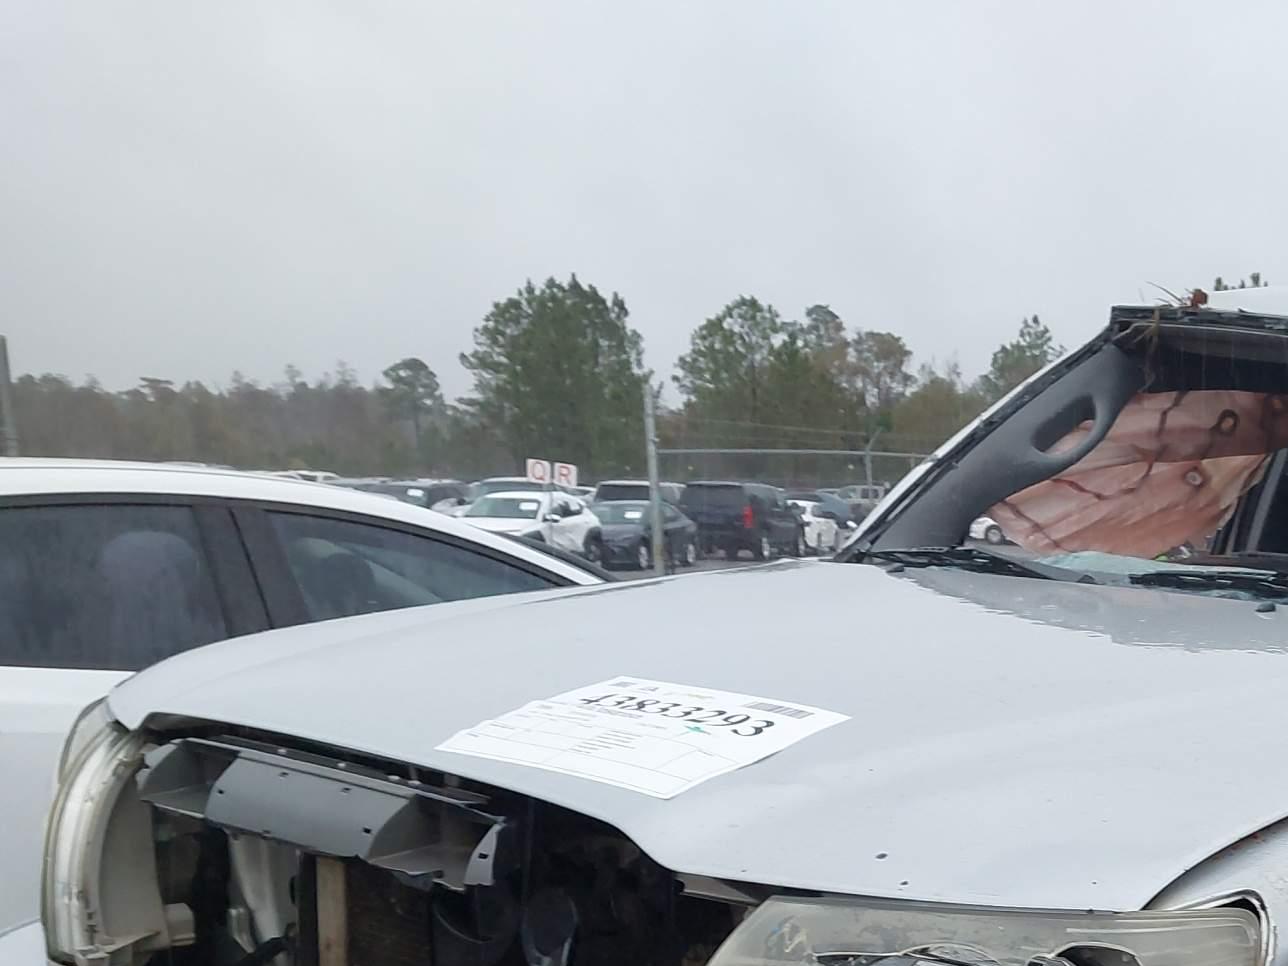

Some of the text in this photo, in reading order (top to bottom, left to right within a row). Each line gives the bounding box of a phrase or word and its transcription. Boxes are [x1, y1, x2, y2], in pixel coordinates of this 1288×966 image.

[532, 461, 545, 481] Q
[559, 465, 572, 486] R
[580, 693, 775, 737] 43833293
